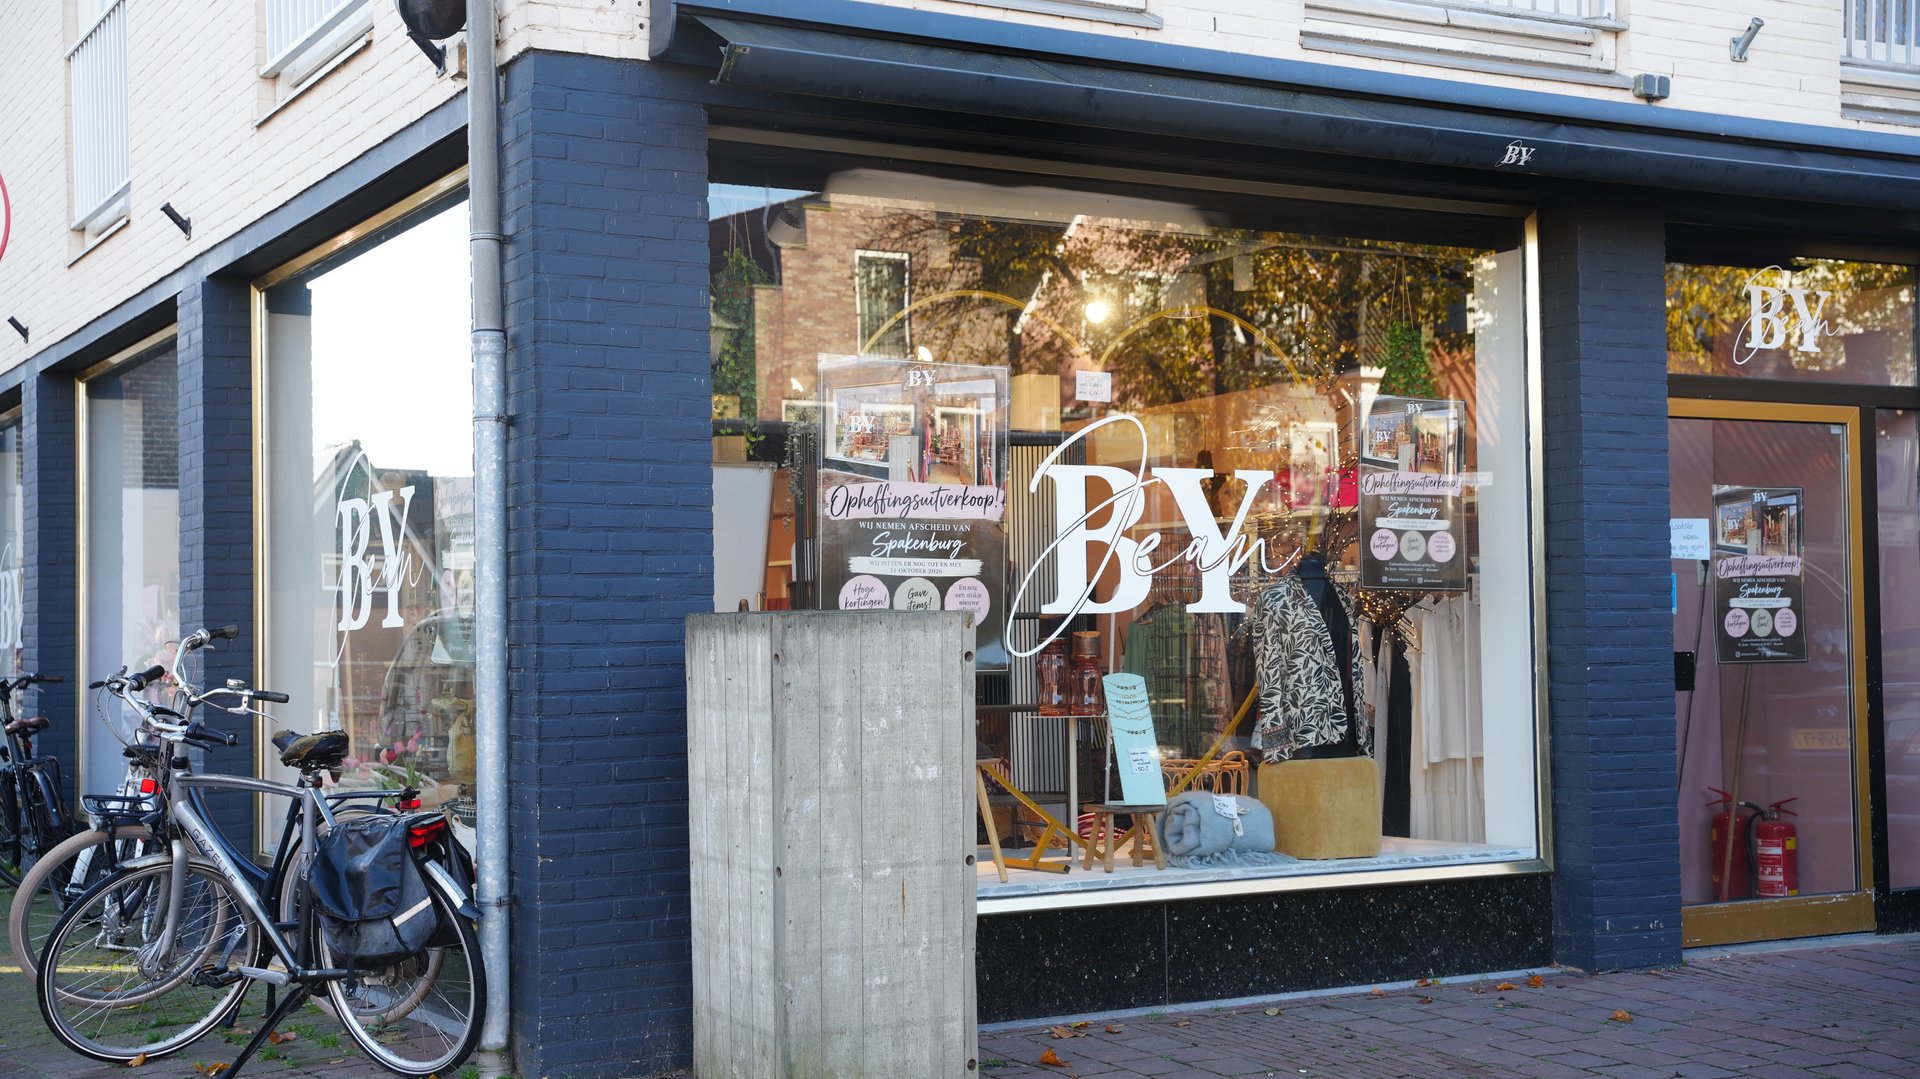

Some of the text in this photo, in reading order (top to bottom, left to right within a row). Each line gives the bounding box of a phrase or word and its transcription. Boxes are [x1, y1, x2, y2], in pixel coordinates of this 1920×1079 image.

[1501, 145, 1536, 166] BY
[1745, 285, 1831, 352] BY
[907, 370, 936, 387] BY
[1406, 403, 1423, 414] BY
[1364, 473, 1460, 494] Opheffingsuitverkoop!
[830, 484, 1000, 519] Opheffingsuitverkoop!
[1753, 491, 1768, 502] BY
[1387, 502, 1440, 520] Spakenburg
[859, 521, 971, 532] WIJ NEMEN AFSCHEID VAN
[870, 531, 967, 560] Spakenburg
[1040, 464, 1274, 614] BY
[337, 485, 416, 631] BY
[1718, 556, 1800, 576] Opheffingsuitverkoop!
[853, 583, 876, 600] Hoge
[907, 587, 929, 600] Gave
[1739, 583, 1784, 600] Spakenburg
[844, 594, 887, 610] kortingen!
[906, 597, 932, 610] items!
[192, 828, 237, 884] GAZELLE
